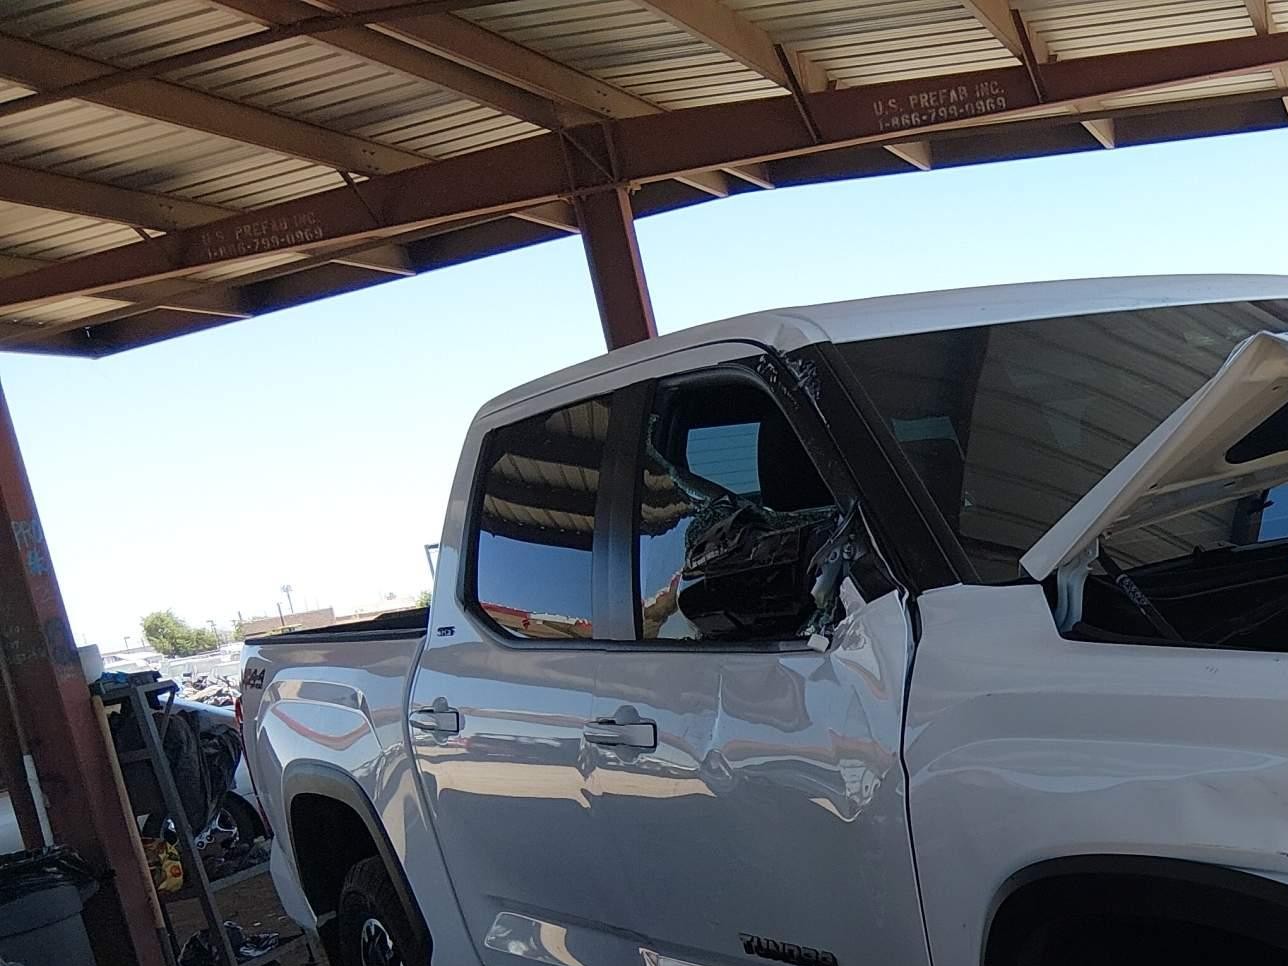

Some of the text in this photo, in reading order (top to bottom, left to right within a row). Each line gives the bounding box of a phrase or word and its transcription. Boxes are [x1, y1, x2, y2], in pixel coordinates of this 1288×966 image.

[872, 80, 1005, 117] U.S. PREFAB INC.
[879, 96, 1006, 131] 1-866-799-0969
